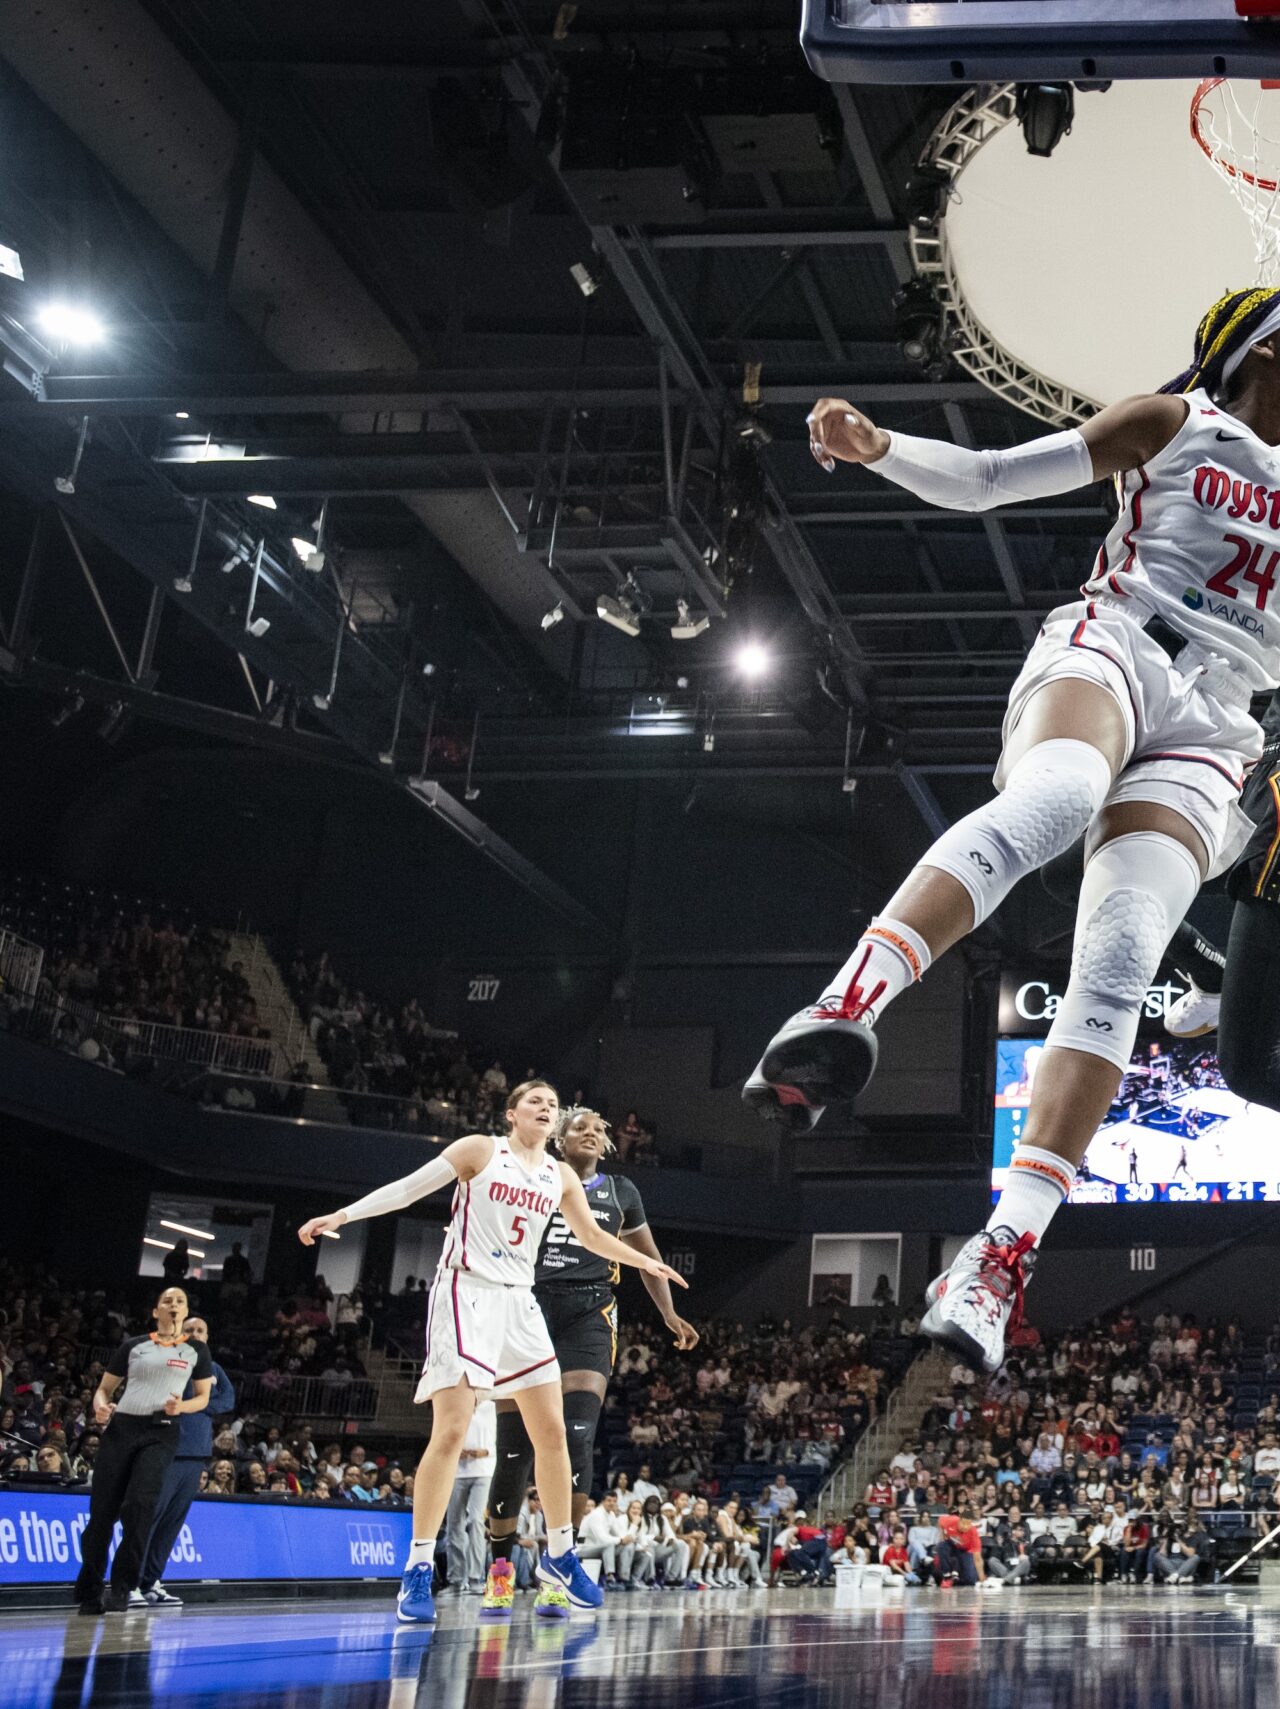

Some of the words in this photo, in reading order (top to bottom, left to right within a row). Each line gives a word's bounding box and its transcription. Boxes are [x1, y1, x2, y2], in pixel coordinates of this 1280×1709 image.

[1207, 598, 1265, 639] VANDA
[467, 980, 501, 1001] 207
[1125, 1183, 1154, 1201] 30
[1227, 1182, 1254, 1200] 21
[508, 1215, 528, 1247] 5
[1130, 1249, 1156, 1271] 110
[19, 1510, 69, 1564] the
[350, 1541, 396, 1566] KPMG
